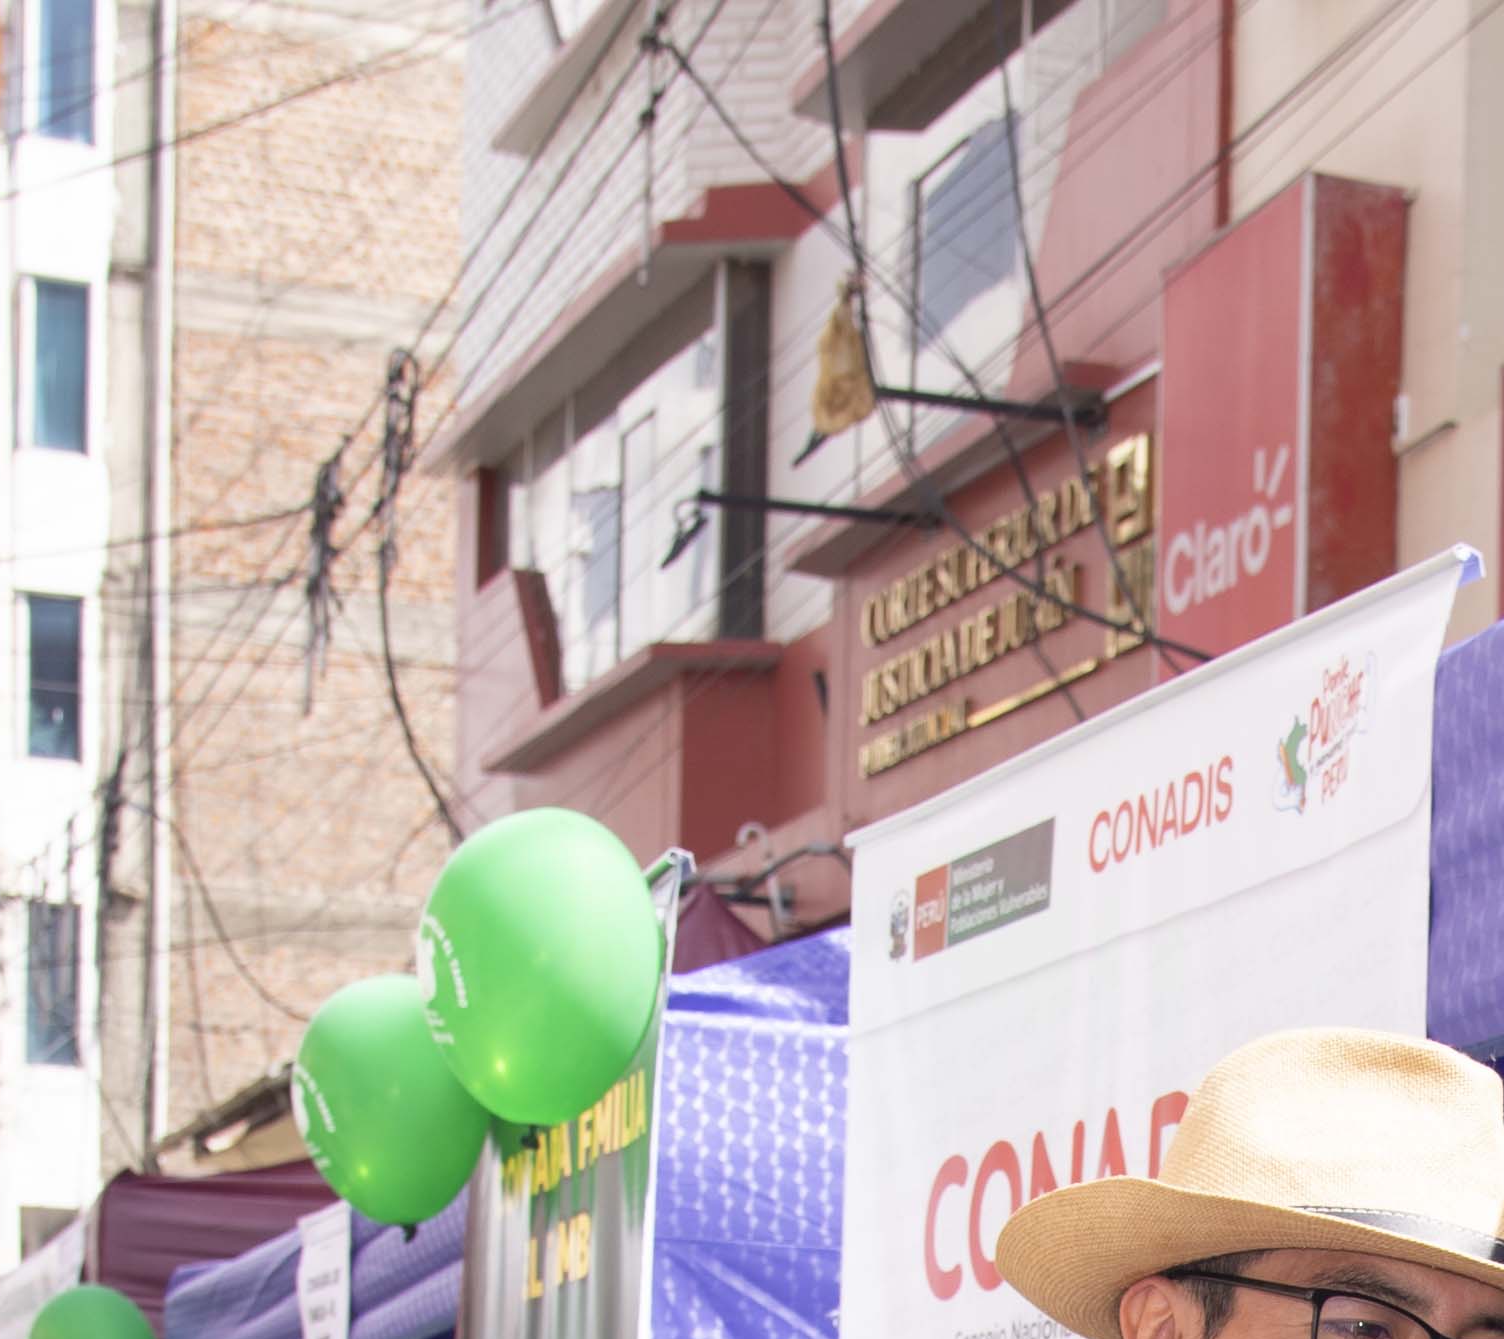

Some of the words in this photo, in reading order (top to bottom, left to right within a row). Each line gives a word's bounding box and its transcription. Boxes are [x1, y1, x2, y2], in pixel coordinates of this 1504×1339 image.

[860, 558, 938, 648] CORTE
[1163, 505, 1272, 617] Claro
[860, 628, 960, 728] JUSTICIA
[1088, 755, 1234, 874] CONADIS
